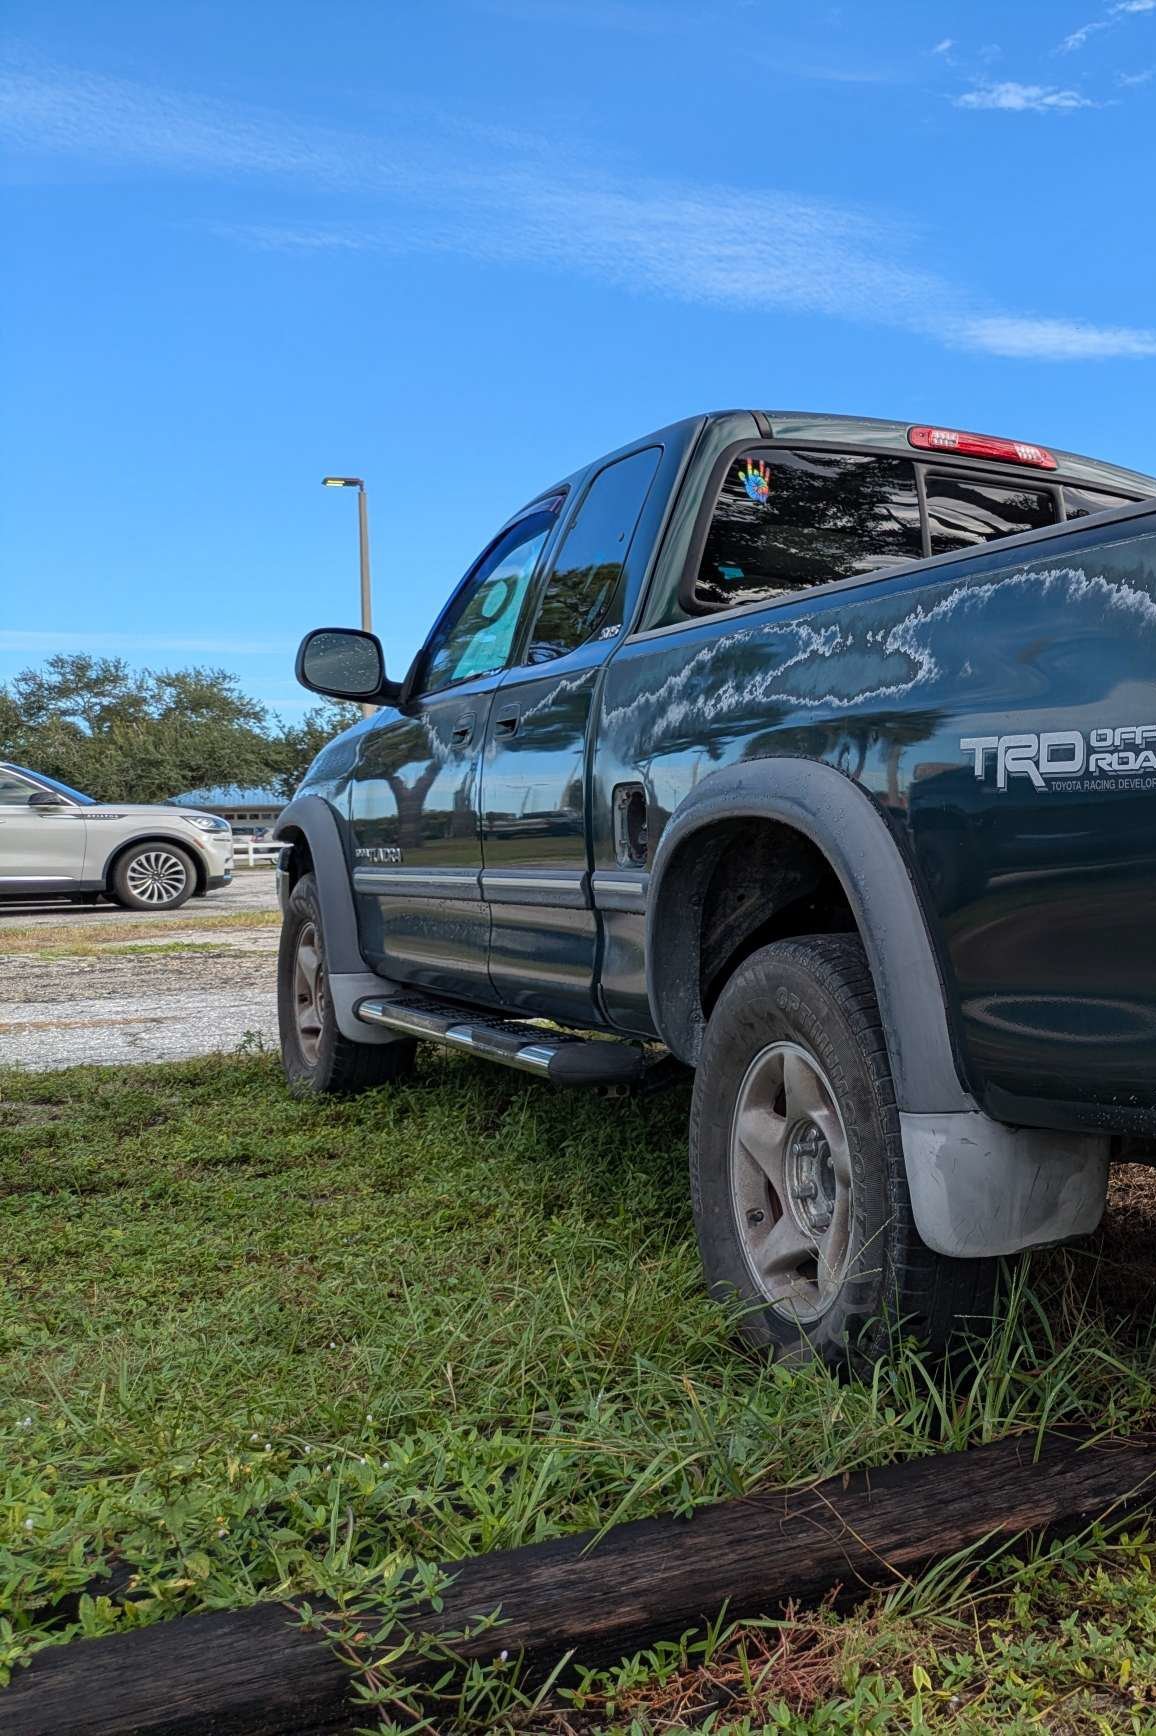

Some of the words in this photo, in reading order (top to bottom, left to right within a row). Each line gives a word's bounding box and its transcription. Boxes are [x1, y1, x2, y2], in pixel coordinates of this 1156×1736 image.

[960, 730, 1086, 789] TRD
[1051, 781, 1081, 791] TOYOTA
[1084, 779, 1115, 791] RACING
